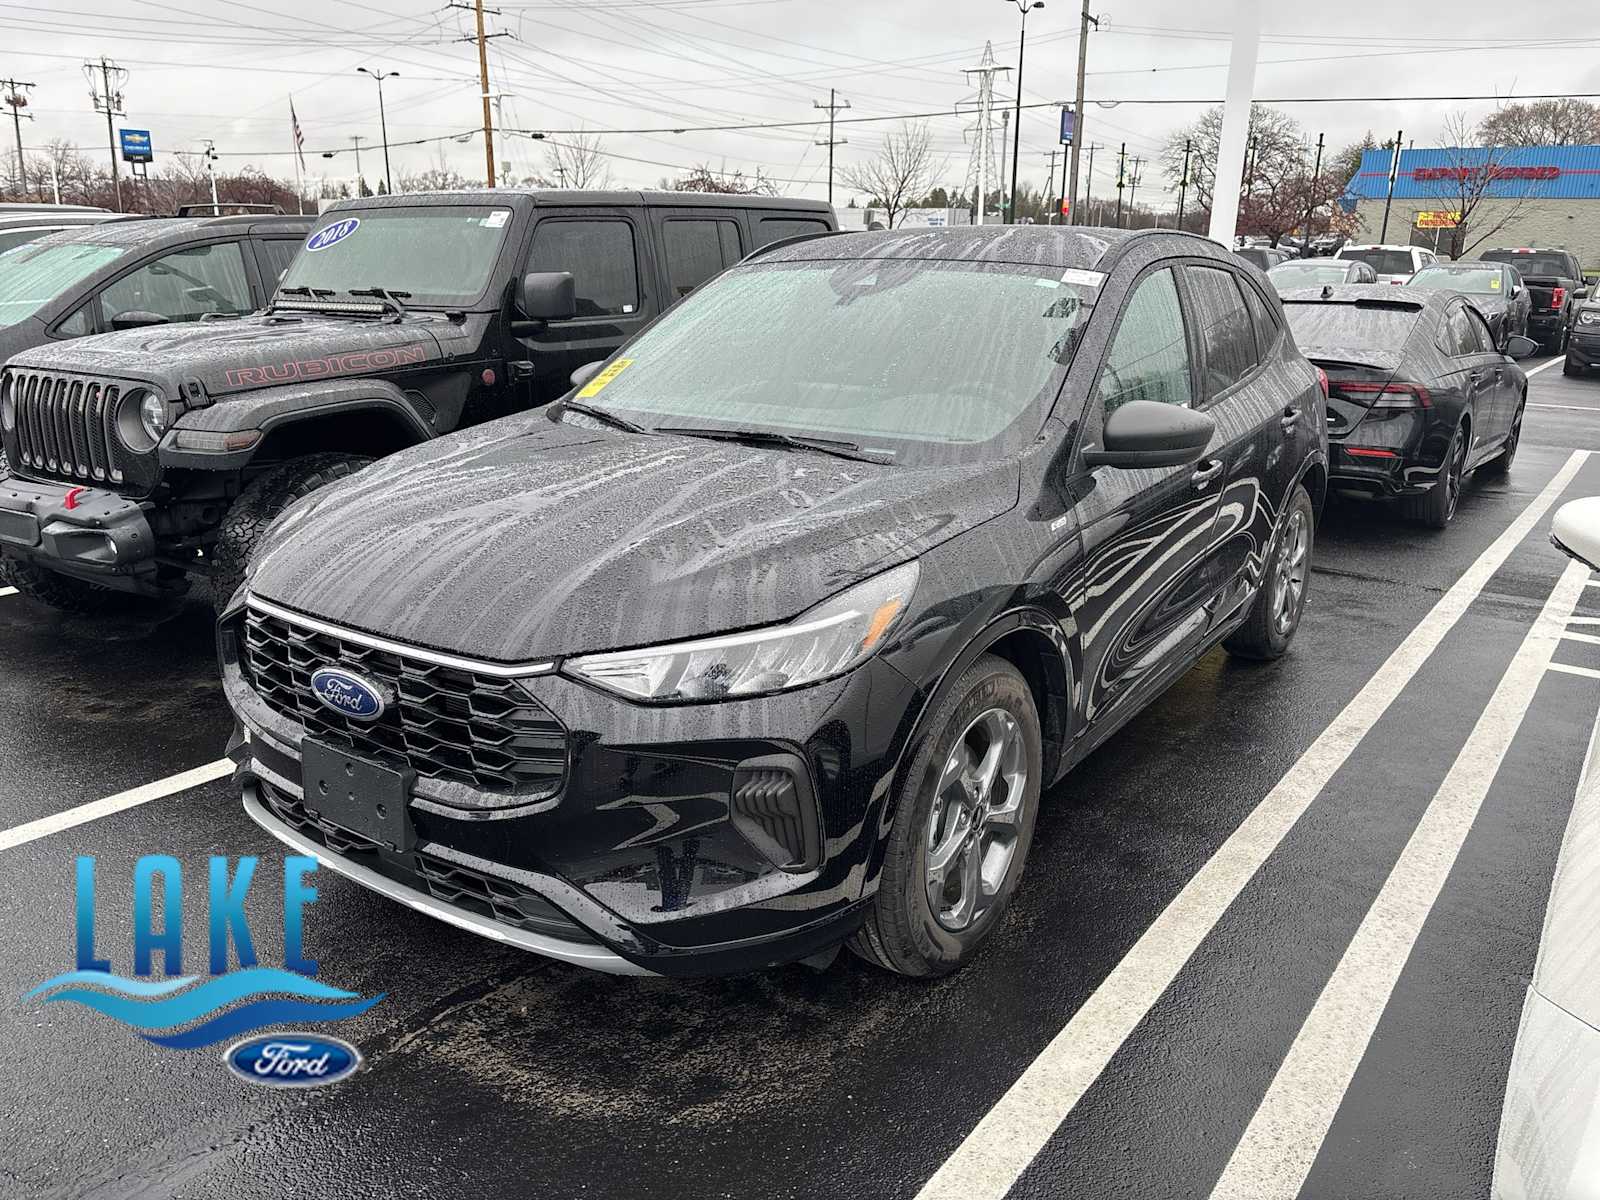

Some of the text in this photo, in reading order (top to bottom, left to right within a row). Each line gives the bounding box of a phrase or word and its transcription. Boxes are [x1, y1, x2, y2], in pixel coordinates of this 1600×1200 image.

[312, 220, 352, 249] 2018
[226, 344, 426, 387] RUBICON
[320, 678, 363, 711] Ford
